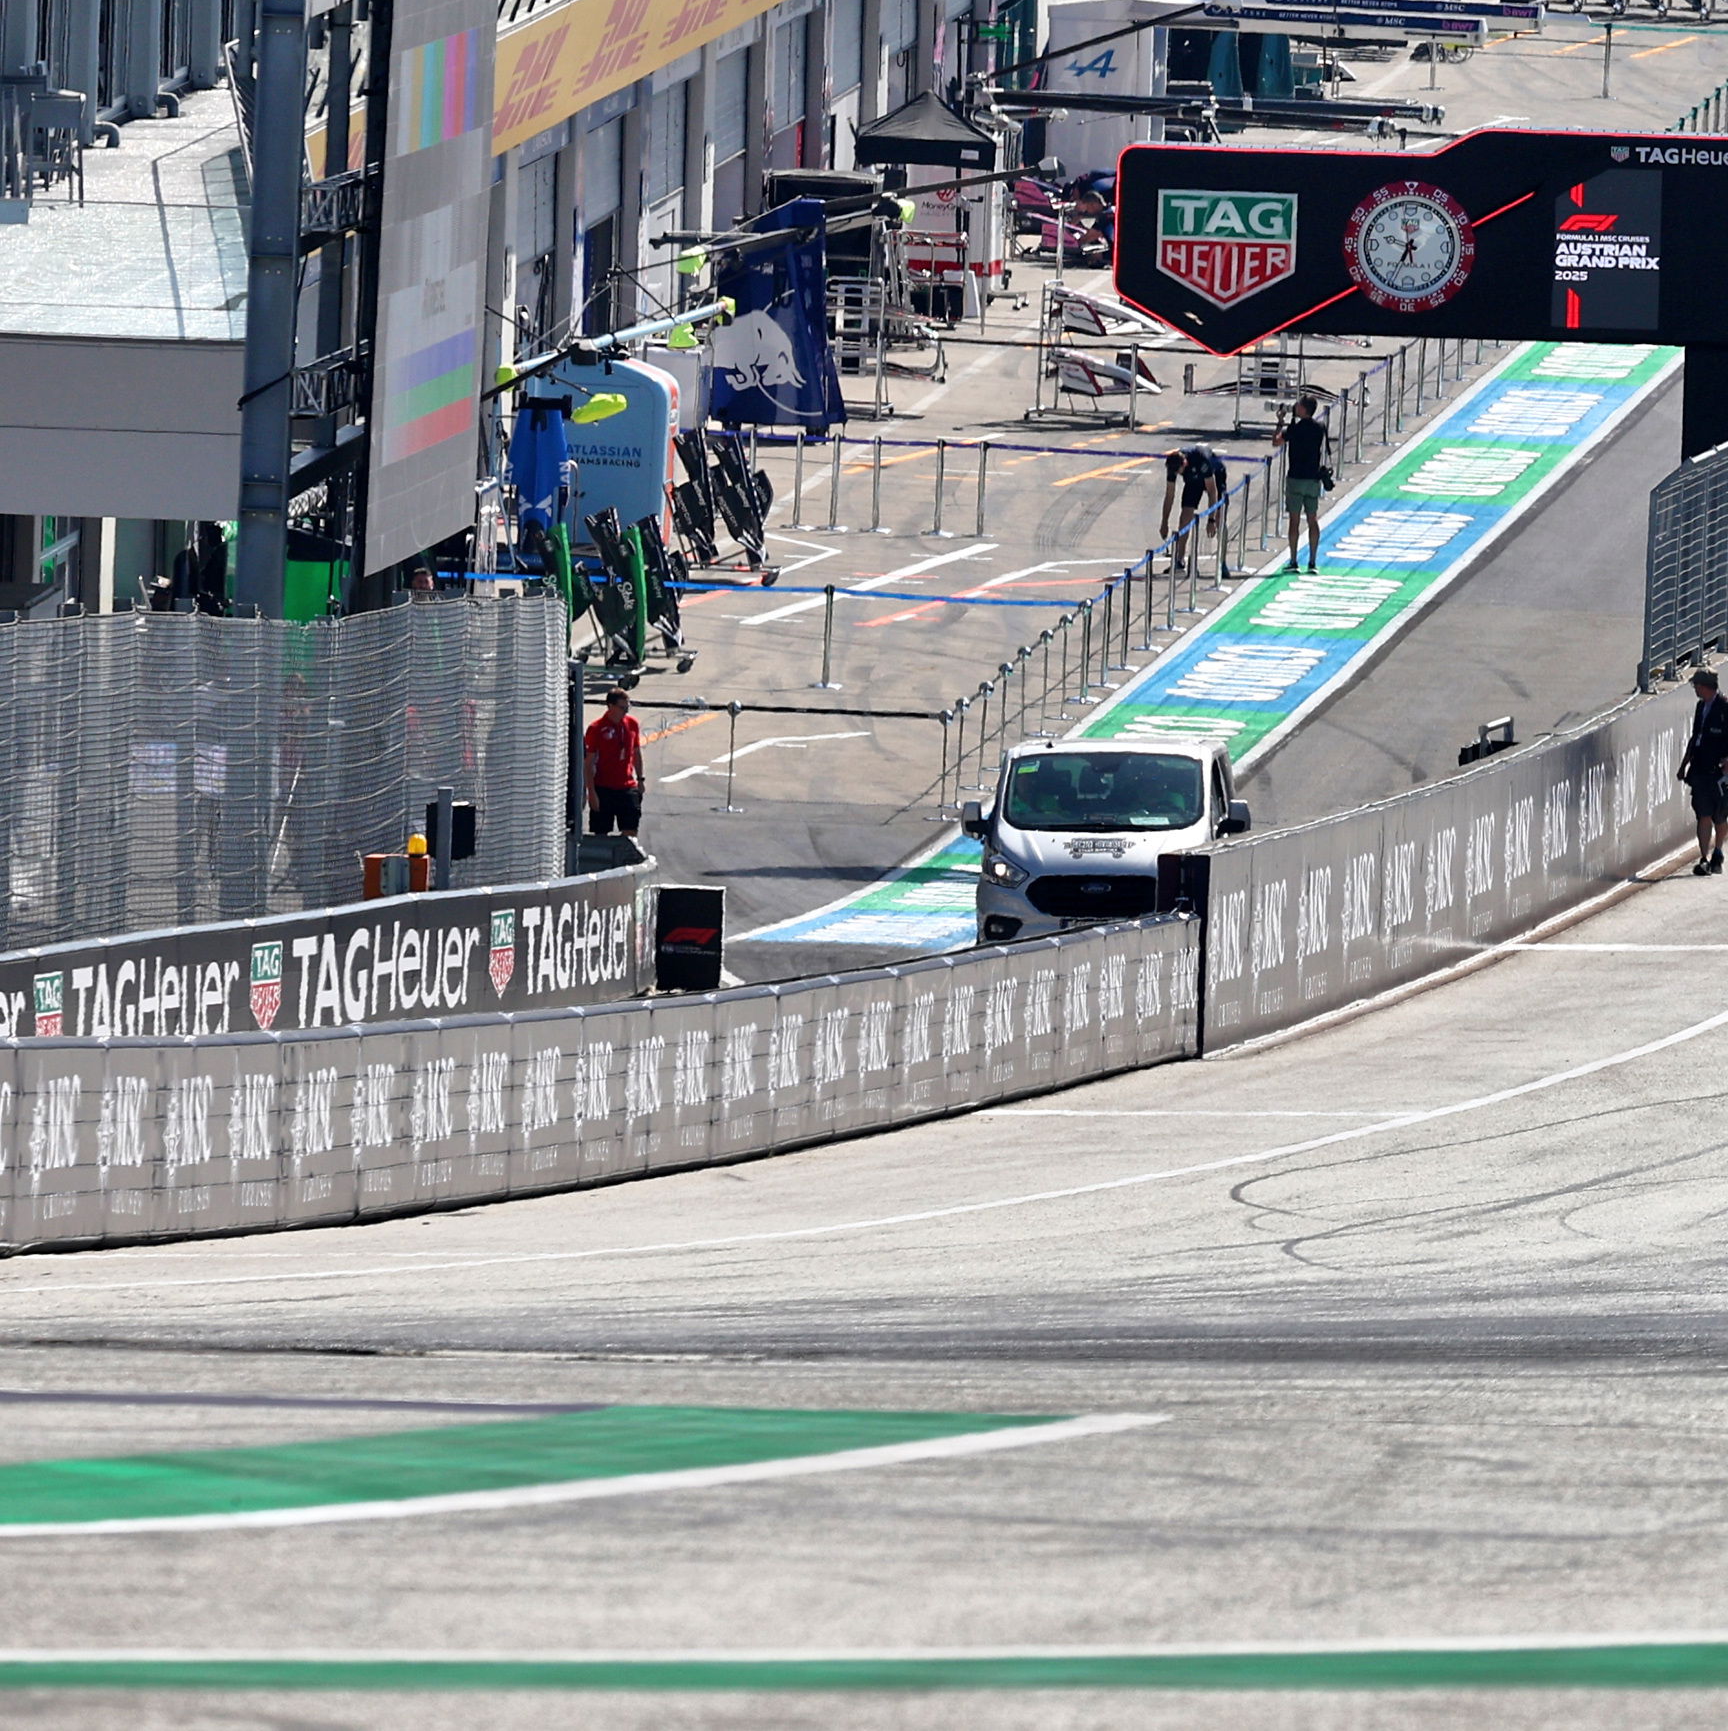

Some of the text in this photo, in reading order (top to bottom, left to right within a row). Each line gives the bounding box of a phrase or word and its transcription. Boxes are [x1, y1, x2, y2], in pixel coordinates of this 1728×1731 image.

[1171, 199, 1283, 235] TAG
[1556, 233, 1594, 241] FORMULA
[1595, 234, 1598, 242] 1
[1618, 235, 1650, 243] CRUISES
[1556, 243, 1647, 256] AUSTRIAN
[1555, 255, 1660, 270] GRAND PRIX
[1167, 244, 1286, 298] HEUER
[1555, 270, 1588, 281] 2025
[567, 444, 642, 458] ATLASSIAN
[602, 458, 641, 468] RACING
[522, 900, 632, 995] TAGHeuer
[293, 920, 481, 1029] TAGHeuer
[72, 956, 240, 1037] TAGHeuer
